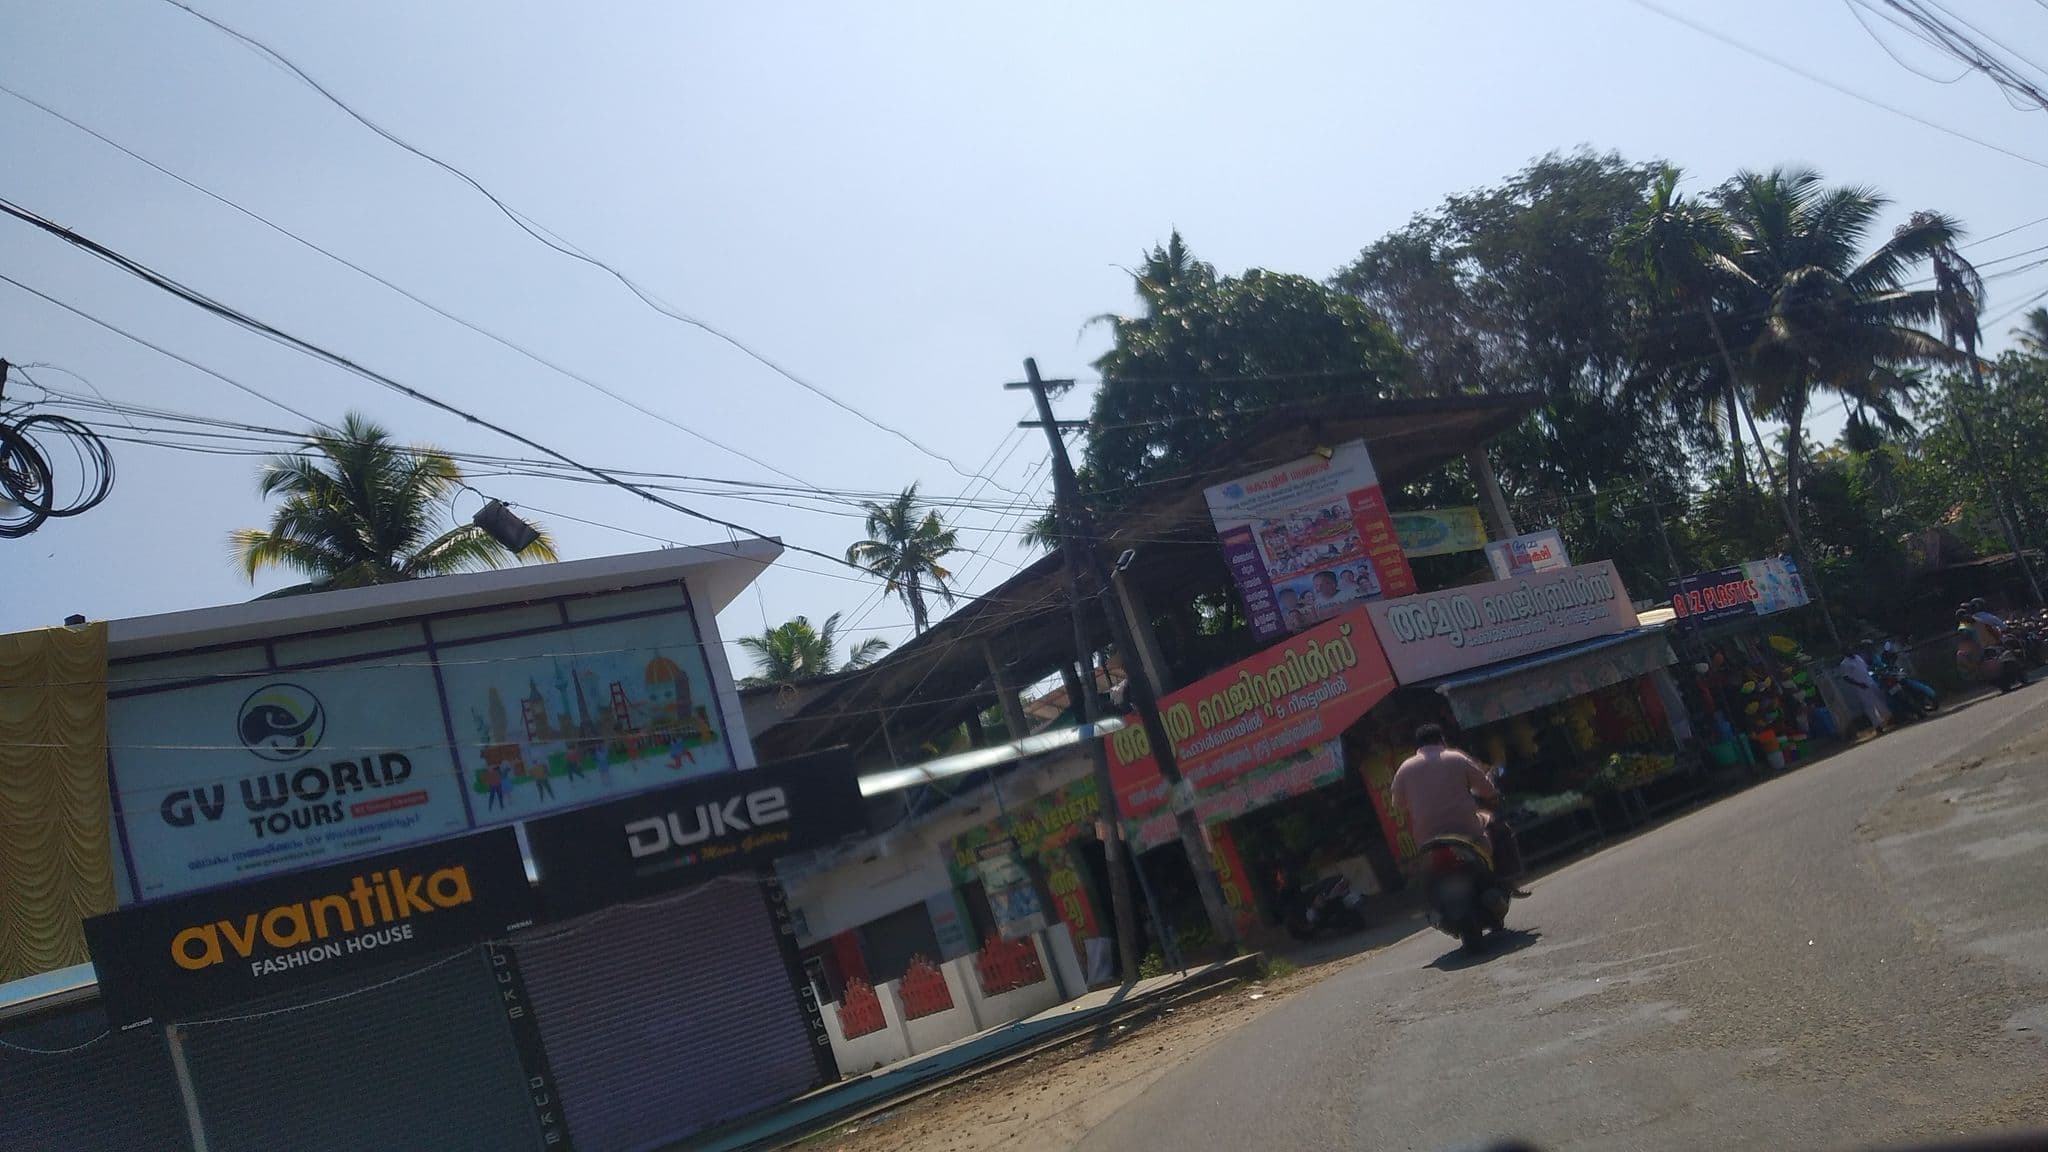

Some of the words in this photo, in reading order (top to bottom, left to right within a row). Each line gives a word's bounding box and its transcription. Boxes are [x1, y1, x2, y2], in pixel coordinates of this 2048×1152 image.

[1387, 594, 1483, 648] അമൃത
[1703, 579, 1760, 611] PLASTICS
[1113, 702, 1196, 766] അത
[1198, 623, 1358, 729] വെജിറ്റബിൾസ്
[161, 783, 225, 828] GV
[239, 752, 412, 811] WORLD
[249, 799, 345, 838] TOURS
[1042, 791, 1099, 834] VEGETA
[624, 785, 791, 859] DUKE
[170, 865, 473, 971] avantika
[251, 941, 341, 977] FASHION
[346, 924, 413, 956] HOUSE
[493, 953, 525, 1019] DUKE
[801, 986, 829, 1046] DUKE
[530, 1075, 561, 1145] DUKE
